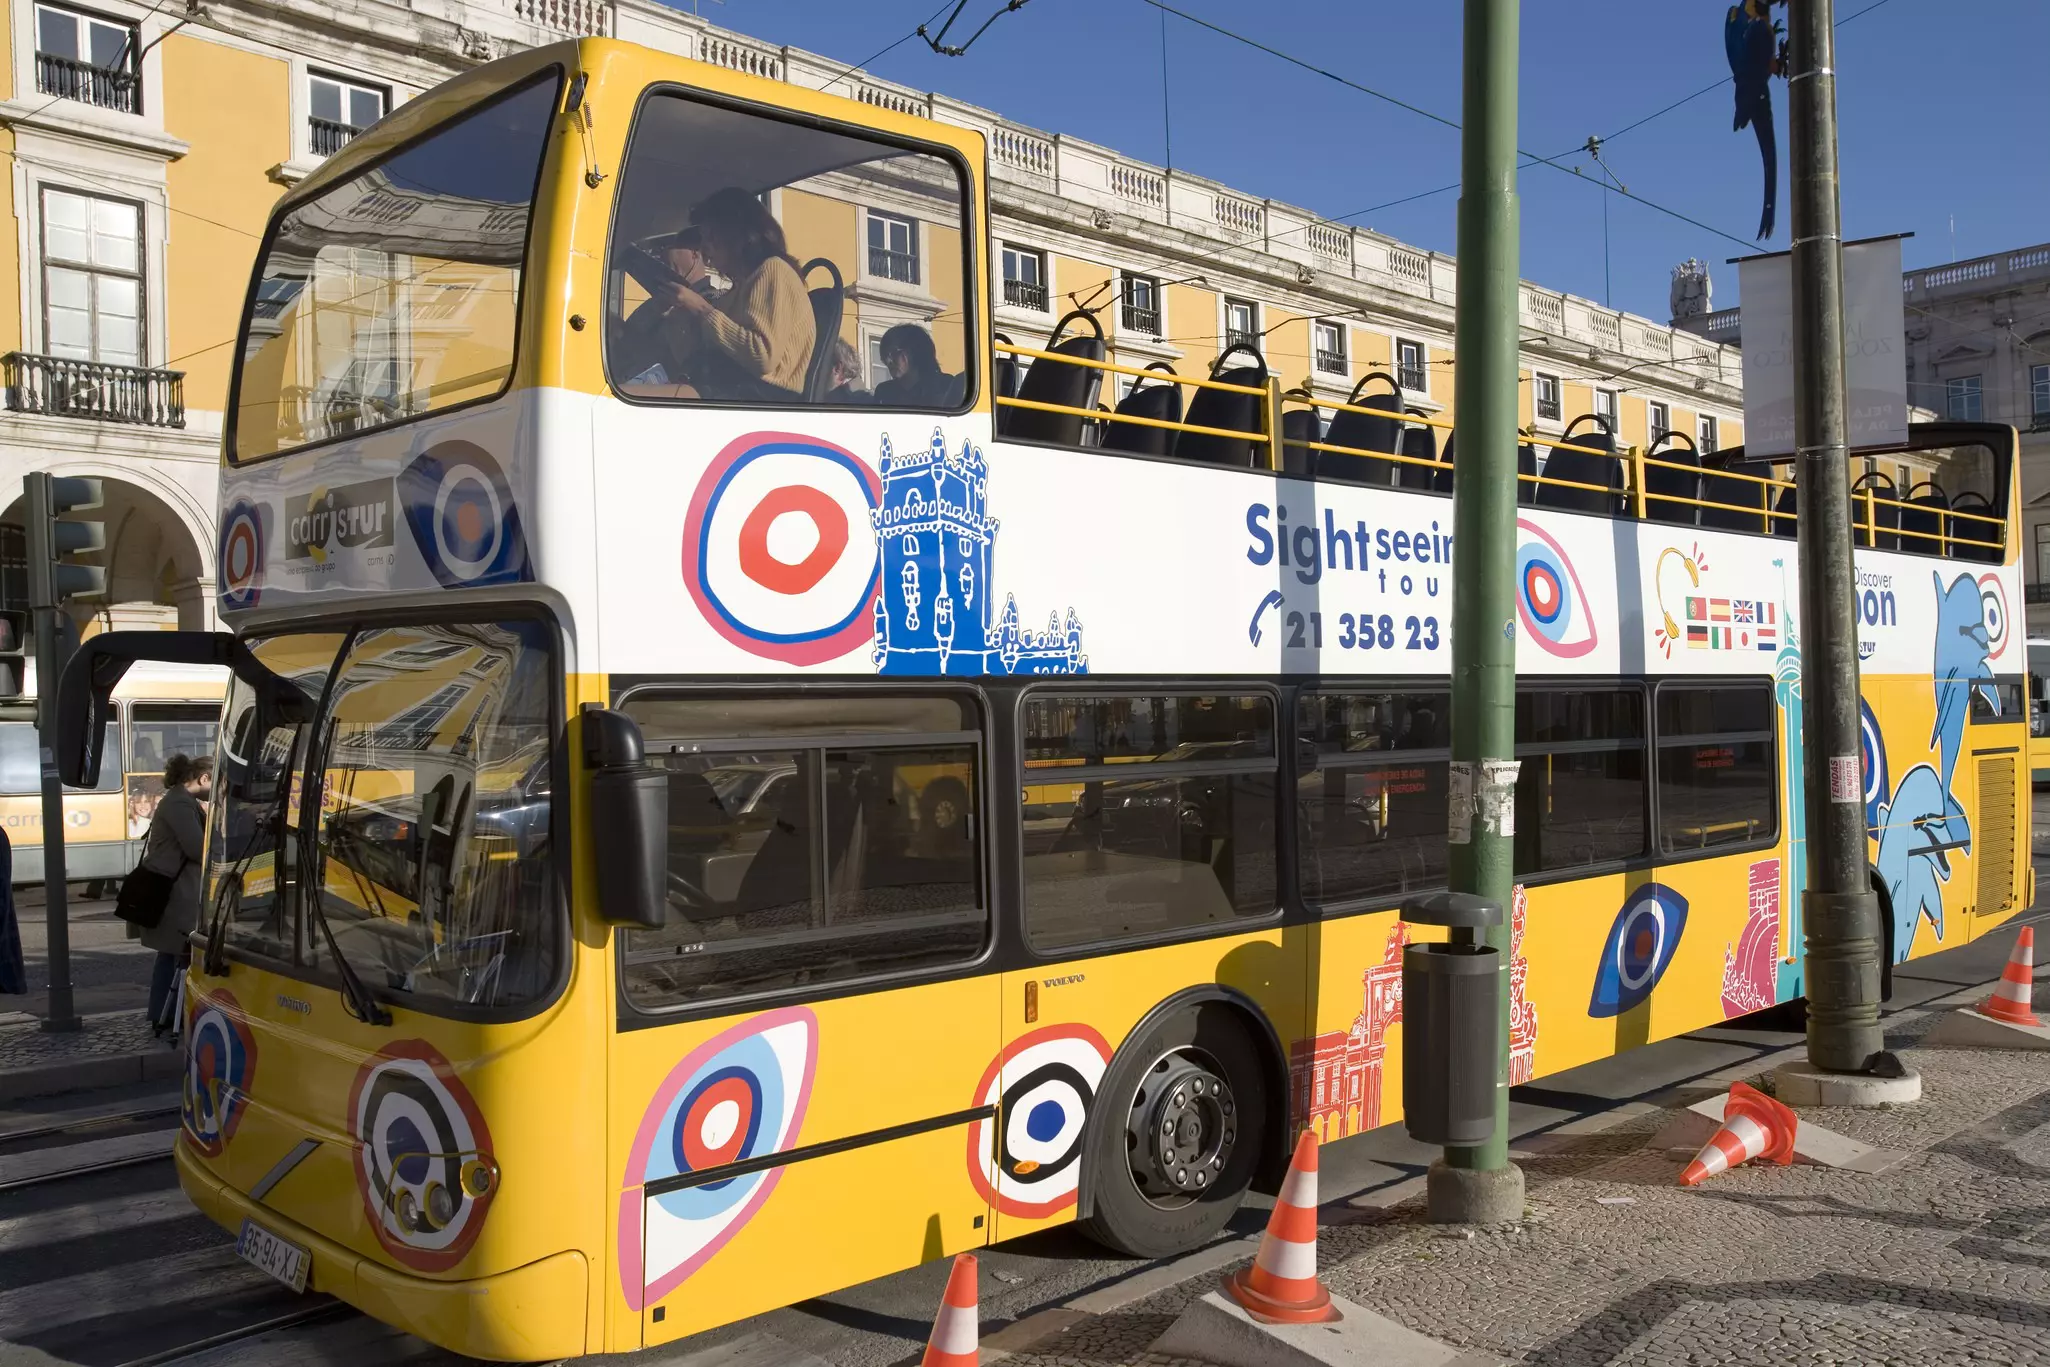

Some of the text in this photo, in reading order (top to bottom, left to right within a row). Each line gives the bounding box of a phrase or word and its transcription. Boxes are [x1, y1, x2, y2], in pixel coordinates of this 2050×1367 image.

[1246, 503, 1453, 585] Sightseein
[1378, 568, 1439, 597] tou
[1286, 611, 1322, 648] 21
[1338, 613, 1395, 650] 358
[1405, 615, 1439, 651] 23
[1830, 760, 1839, 799] TENDAS
[1043, 974, 1085, 988] VOLVO
